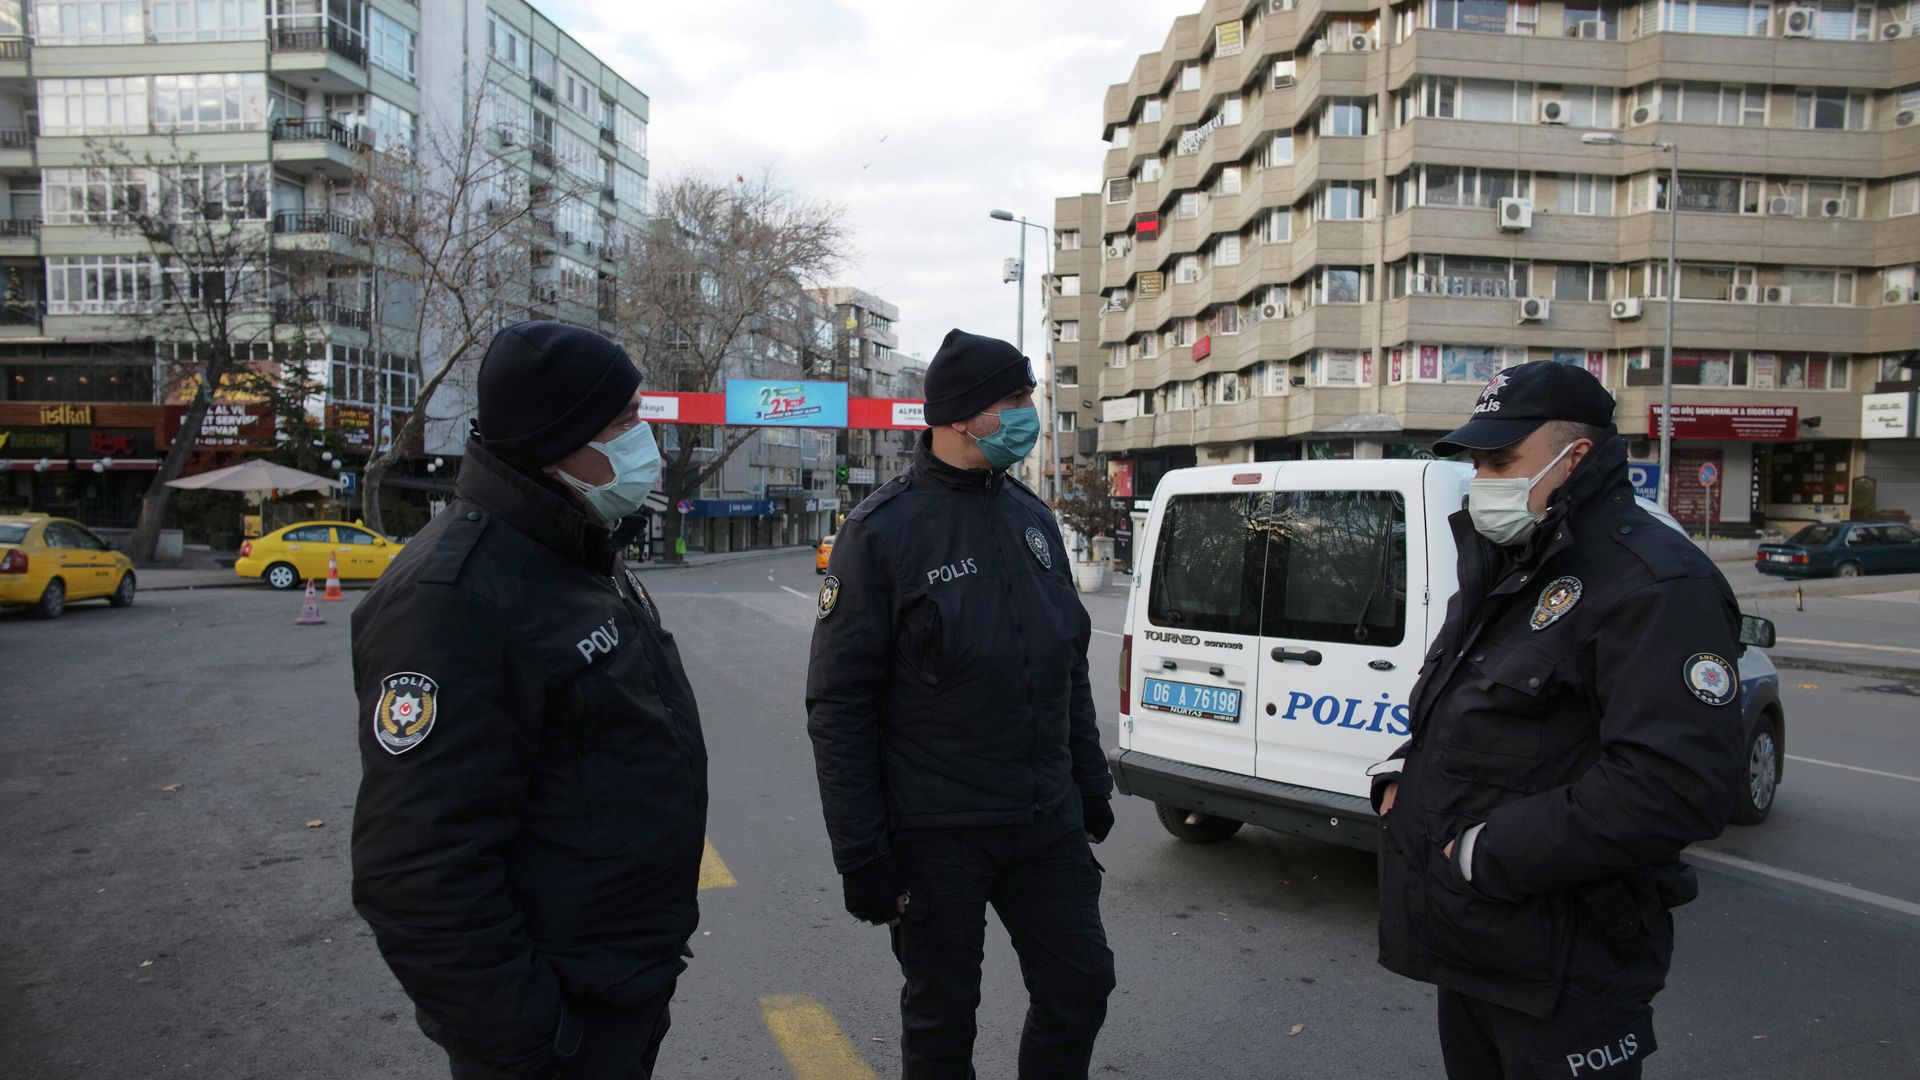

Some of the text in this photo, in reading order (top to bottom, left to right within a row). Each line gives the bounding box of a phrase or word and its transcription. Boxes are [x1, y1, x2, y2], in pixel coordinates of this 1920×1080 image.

[1423, 346, 1434, 377] THY
[640, 403, 665, 412] nkaya
[1695, 406, 1739, 417] DANIŞMANLIK
[926, 557, 978, 585] POLİS
[1144, 629, 1243, 650] TOURNEO connect
[389, 676, 433, 692] POLİS
[1153, 682, 1238, 714] 06 A 76198
[1281, 691, 1412, 736] POLİS
[1566, 1033, 1639, 1078] POLİS
